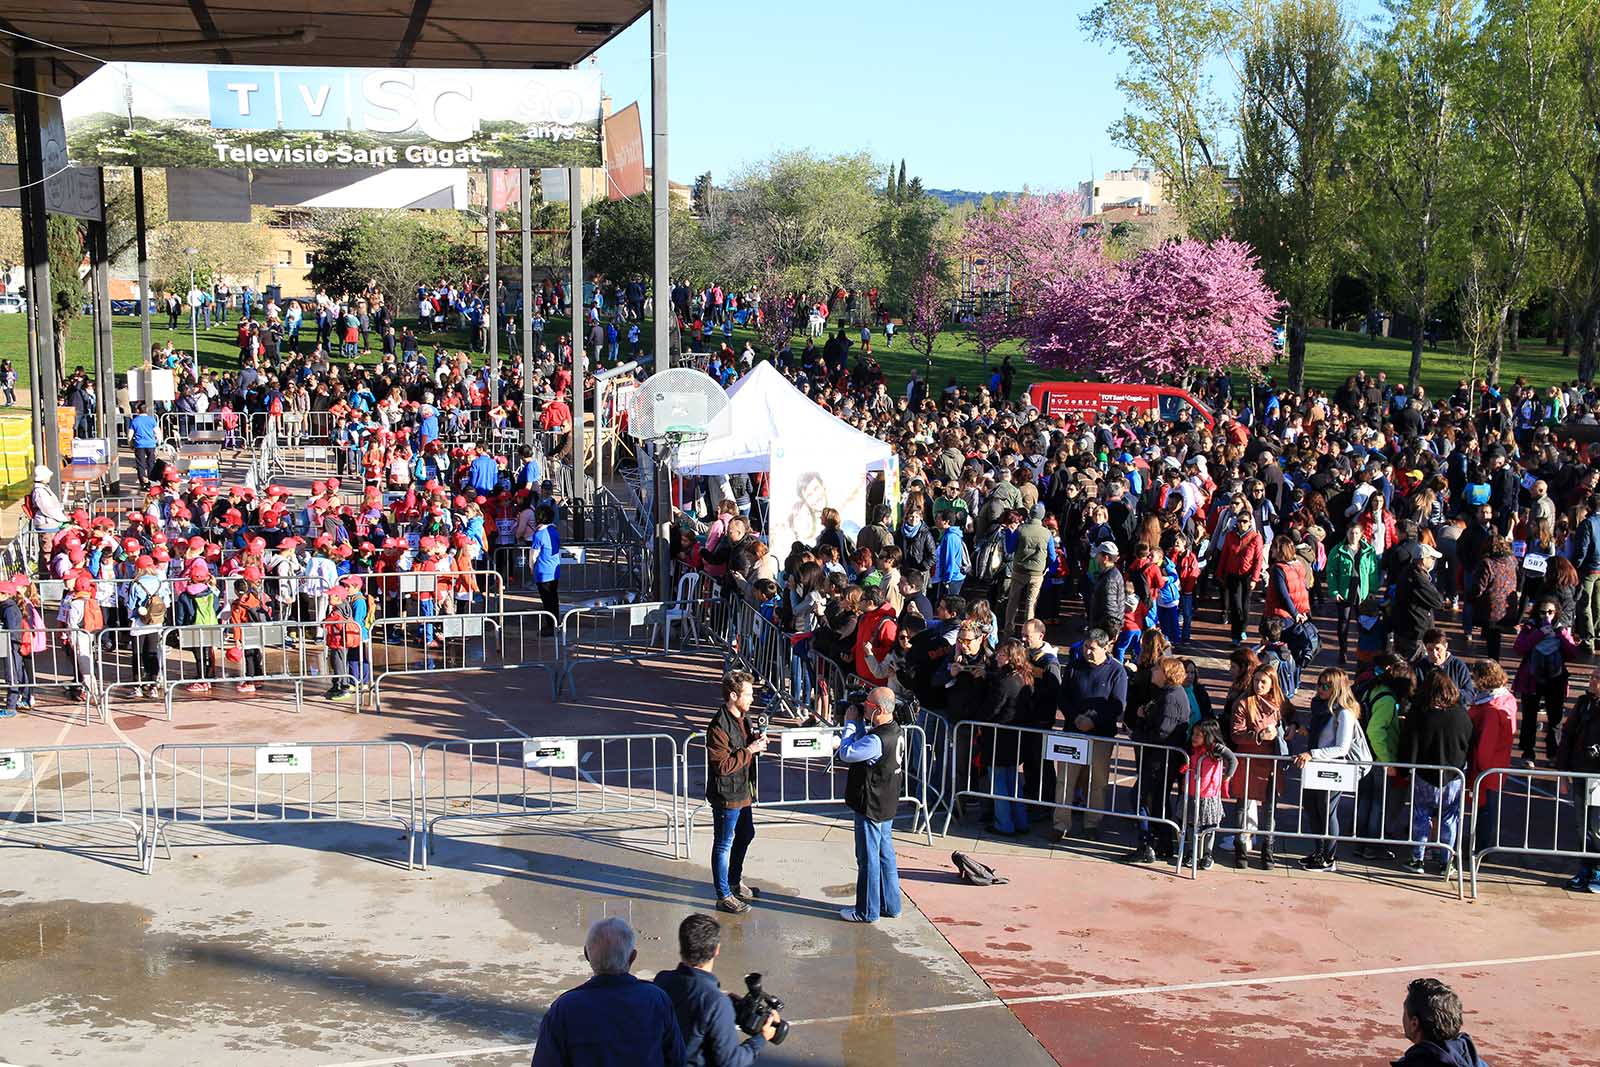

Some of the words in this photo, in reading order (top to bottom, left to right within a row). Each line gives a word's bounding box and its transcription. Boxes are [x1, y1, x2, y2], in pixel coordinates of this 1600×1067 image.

[526, 126, 574, 142] anys
[213, 143, 330, 163] Televisió
[336, 144, 398, 164] Sant
[404, 144, 482, 167] Cugat
[1527, 558, 1544, 568] 587
